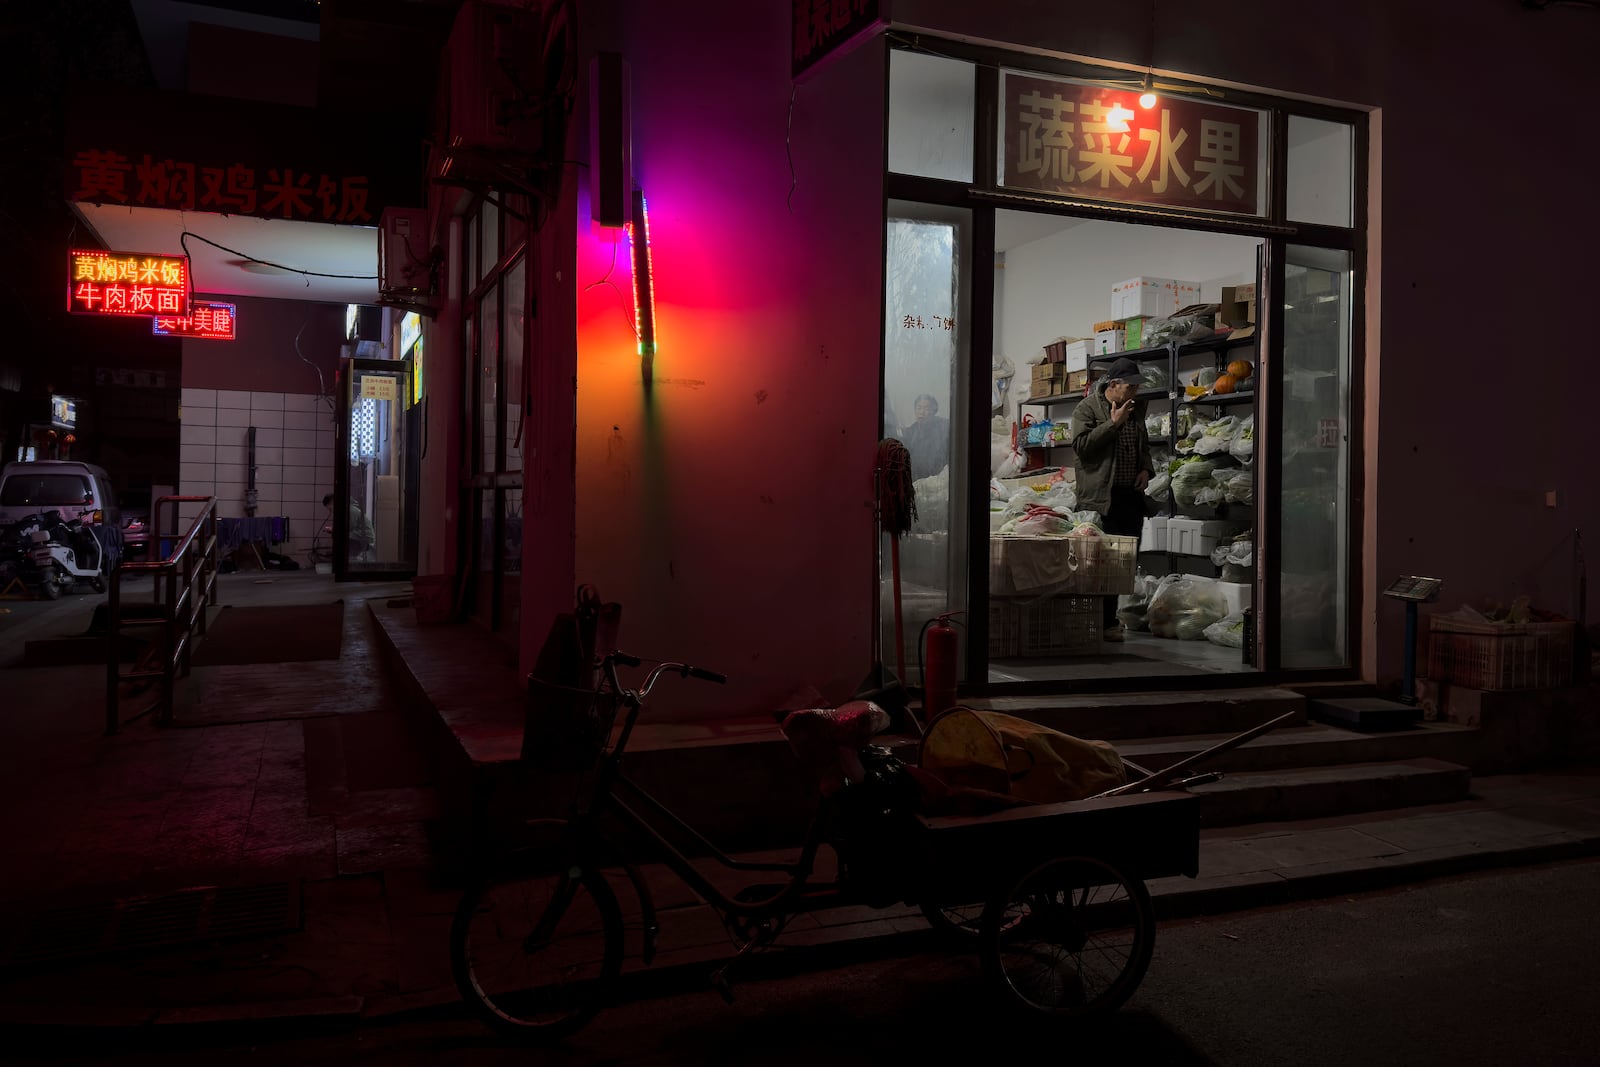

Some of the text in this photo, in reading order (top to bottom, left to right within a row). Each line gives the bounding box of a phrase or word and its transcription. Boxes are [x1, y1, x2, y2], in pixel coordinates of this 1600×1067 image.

[1016, 90, 1245, 200] 蔬菜水果
[72, 148, 373, 223] 黄焖鸡米饭
[75, 256, 181, 285] 黄焖鸡米饭
[75, 283, 181, 313] 牛肉板面
